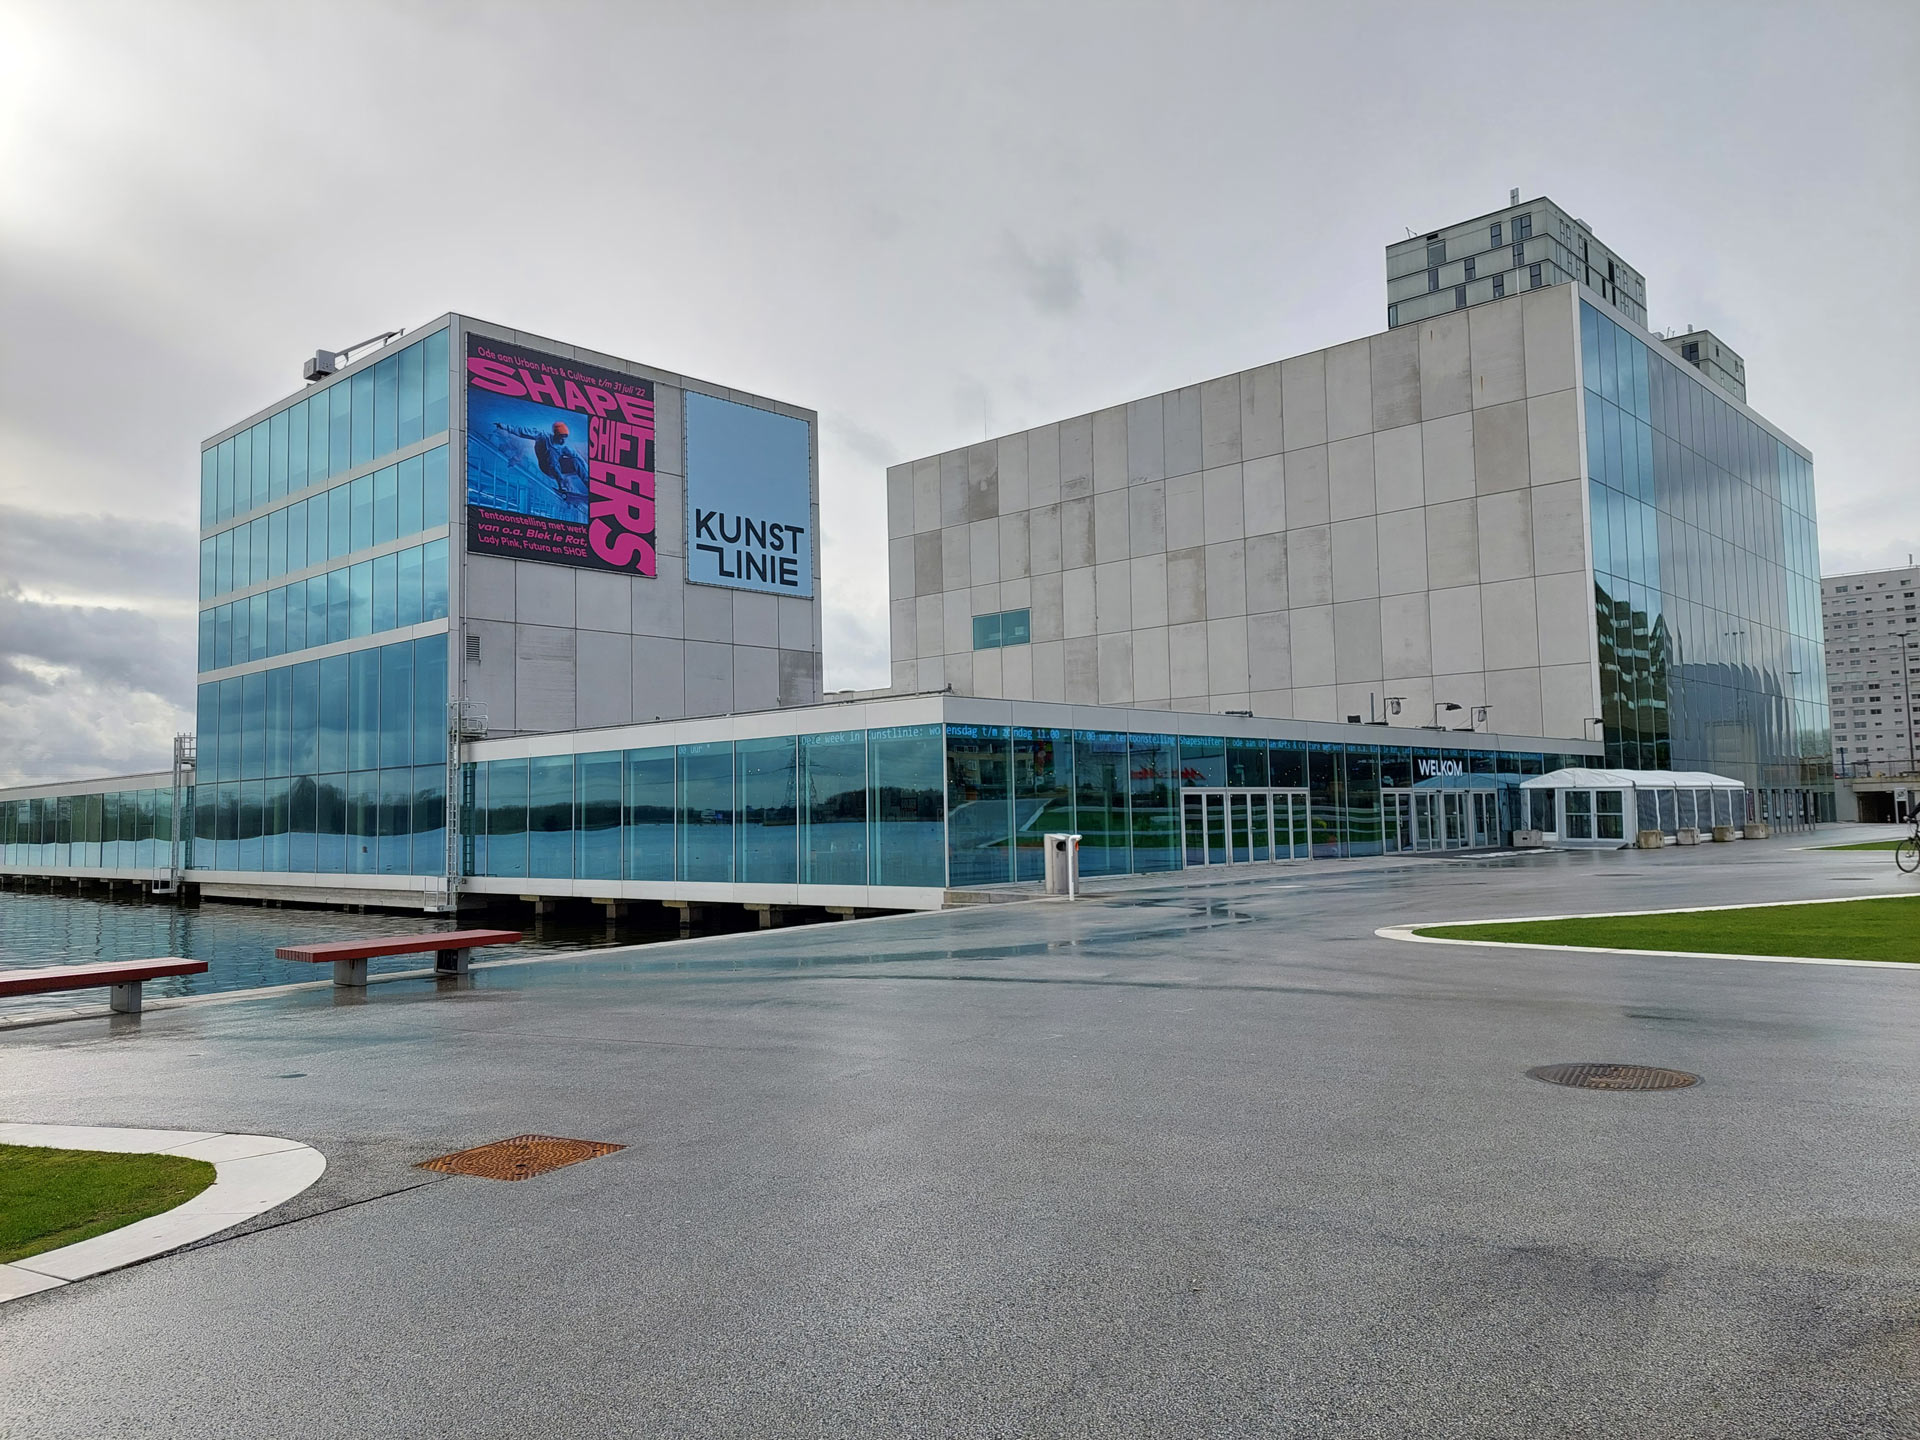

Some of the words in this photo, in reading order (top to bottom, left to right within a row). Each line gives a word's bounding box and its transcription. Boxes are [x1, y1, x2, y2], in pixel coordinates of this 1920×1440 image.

[467, 357, 655, 428] SHAPE
[478, 346, 496, 360] Ode
[498, 354, 513, 364] aan
[514, 355, 540, 370] Urban
[541, 363, 559, 376] Arts
[559, 368, 567, 377] &
[567, 370, 596, 385] Culture
[598, 378, 612, 388] t/m
[614, 381, 622, 391] 31
[621, 384, 634, 395] juli
[634, 387, 646, 397] '22
[589, 415, 655, 469] SHIFT
[478, 508, 547, 530] Tentoonstelling
[548, 521, 566, 532] met
[566, 524, 588, 535] werk
[478, 522, 500, 533] van
[502, 526, 524, 537] o.a.
[526, 528, 551, 541] Blek
[552, 532, 563, 543] le
[565, 534, 588, 547] Rat,
[589, 459, 656, 577] ERS
[695, 508, 804, 554] KUNST
[477, 533, 500, 547] Lady
[501, 536, 523, 549] Pink,
[523, 540, 551, 553] Futura
[552, 545, 563, 554] en
[563, 546, 588, 558] SHOE
[696, 543, 798, 587] LINIE
[801, 735, 821, 746] Deze
[825, 733, 845, 744] week
[850, 731, 860, 742] in
[1418, 758, 1463, 777] WELKOM
